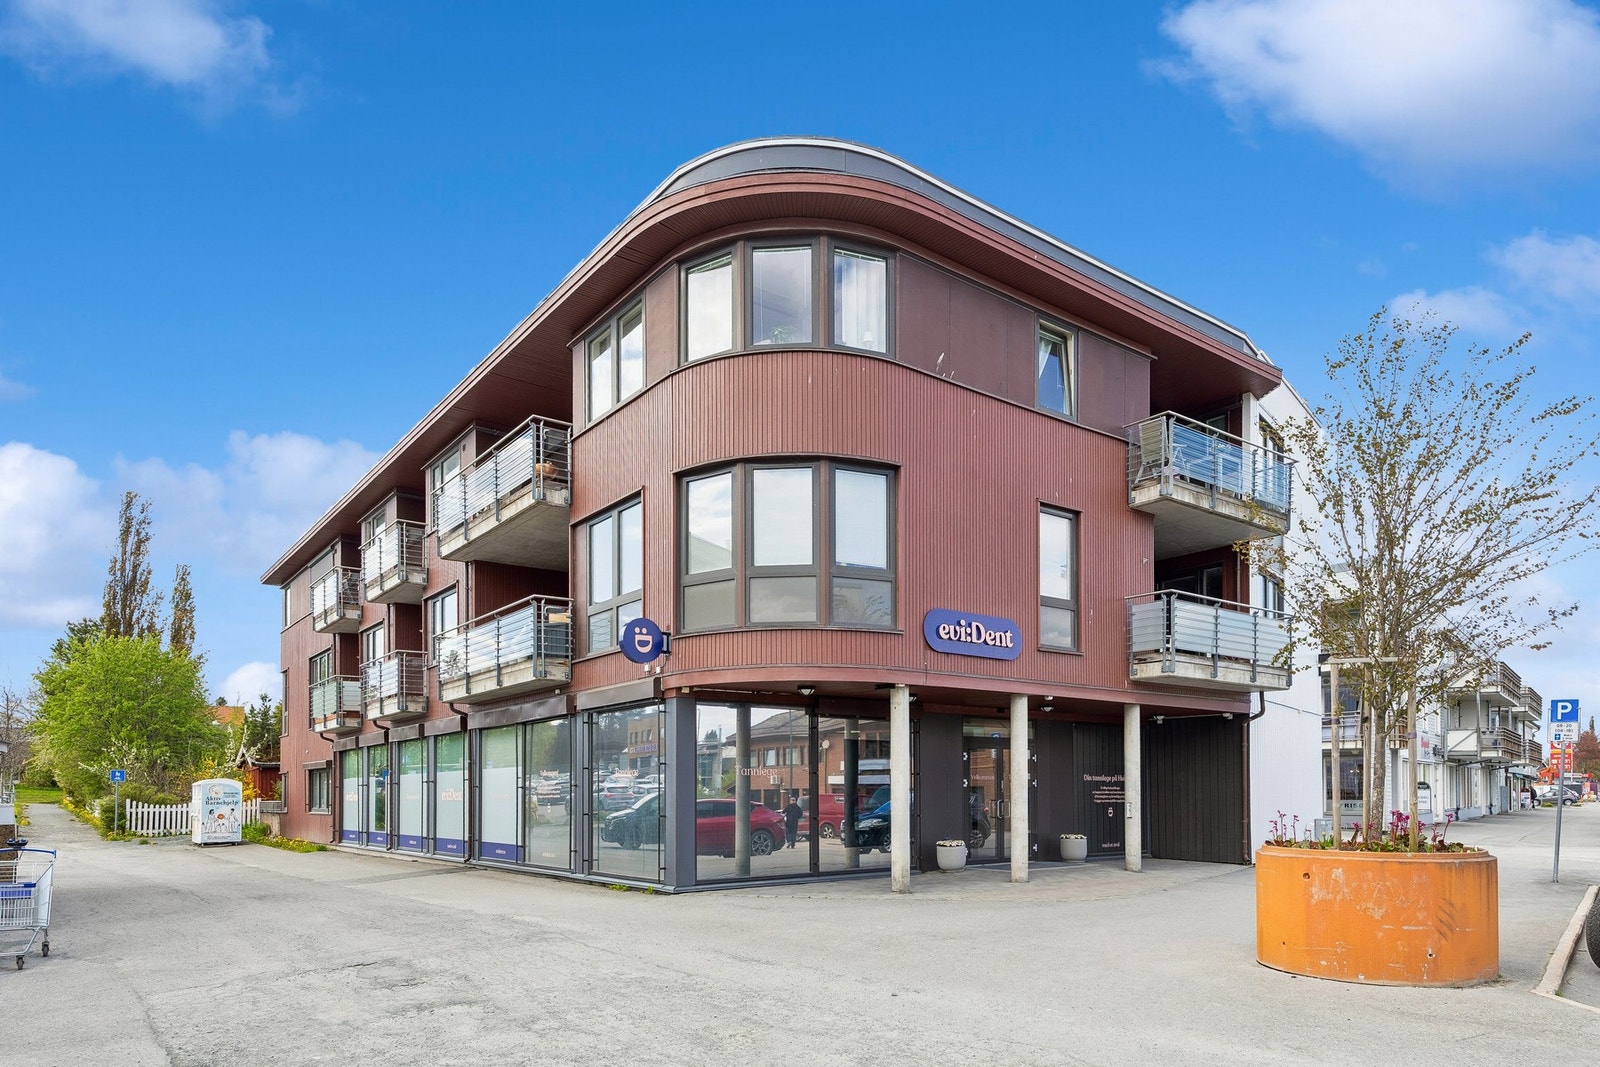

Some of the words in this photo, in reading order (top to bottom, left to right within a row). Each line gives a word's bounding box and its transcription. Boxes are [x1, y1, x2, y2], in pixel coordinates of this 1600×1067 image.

[938, 619, 1014, 648] evi:Dent
[1556, 702, 1573, 720] P
[735, 764, 778, 779] Tannlege
